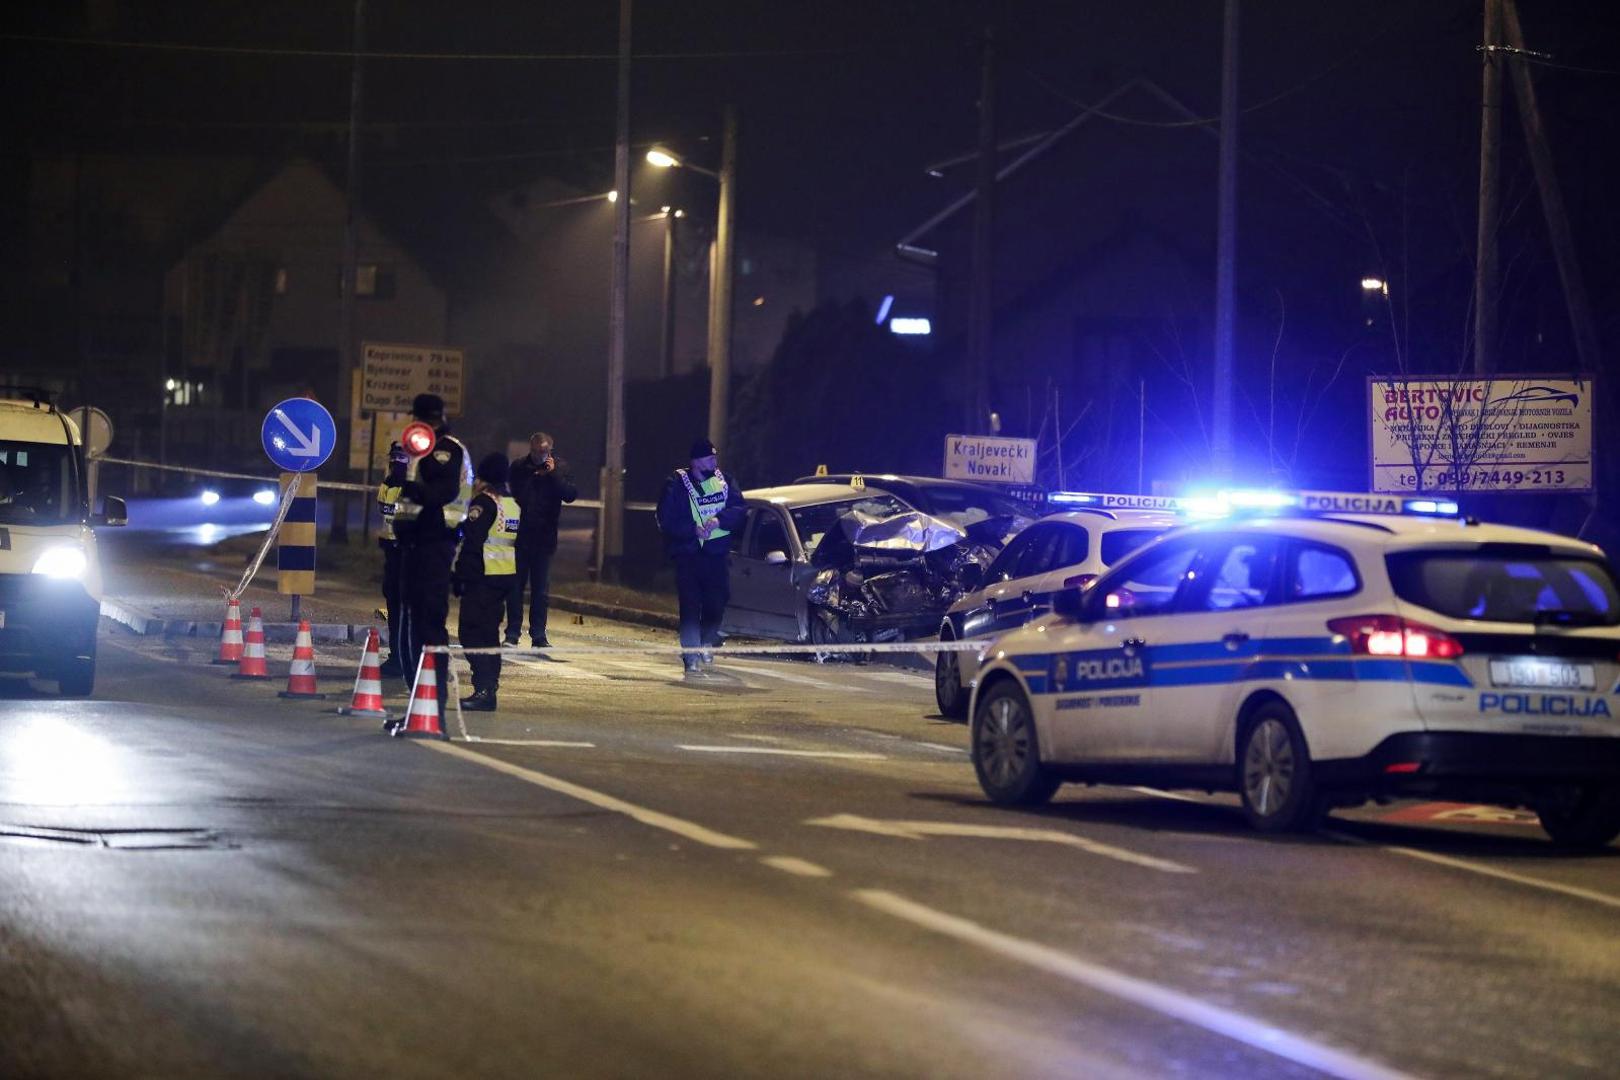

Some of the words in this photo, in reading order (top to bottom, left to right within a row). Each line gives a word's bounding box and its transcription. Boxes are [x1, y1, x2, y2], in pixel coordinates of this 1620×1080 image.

[444, 353, 460, 363] km
[367, 363, 413, 377] Bjelovar
[443, 369, 459, 379] km
[443, 384, 459, 394] km
[394, 394, 414, 406] Sel
[1384, 405, 1440, 421] AUTO
[1389, 424, 1436, 434] MEHNIKA
[1444, 423, 1468, 433] ATO
[1470, 423, 1509, 432] DELOVI
[1518, 422, 1580, 431] DIJAGNOSTIKA
[1395, 432, 1440, 441] PRIREMA
[1496, 431, 1537, 440] PREGLED
[1547, 431, 1575, 439] OVJES
[953, 440, 1029, 460] Kraljevečki
[1516, 441, 1557, 449] REMENJE
[818, 466, 825, 474] 4
[967, 460, 1013, 477] Novaki
[854, 476, 863, 486] 11
[1400, 472, 1434, 487] te.:
[1106, 495, 1178, 509] POLICIJA
[1305, 495, 1397, 514] POLICIJA
[1077, 657, 1144, 680] POLICIJA
[1478, 692, 1612, 718] POLICIJA
